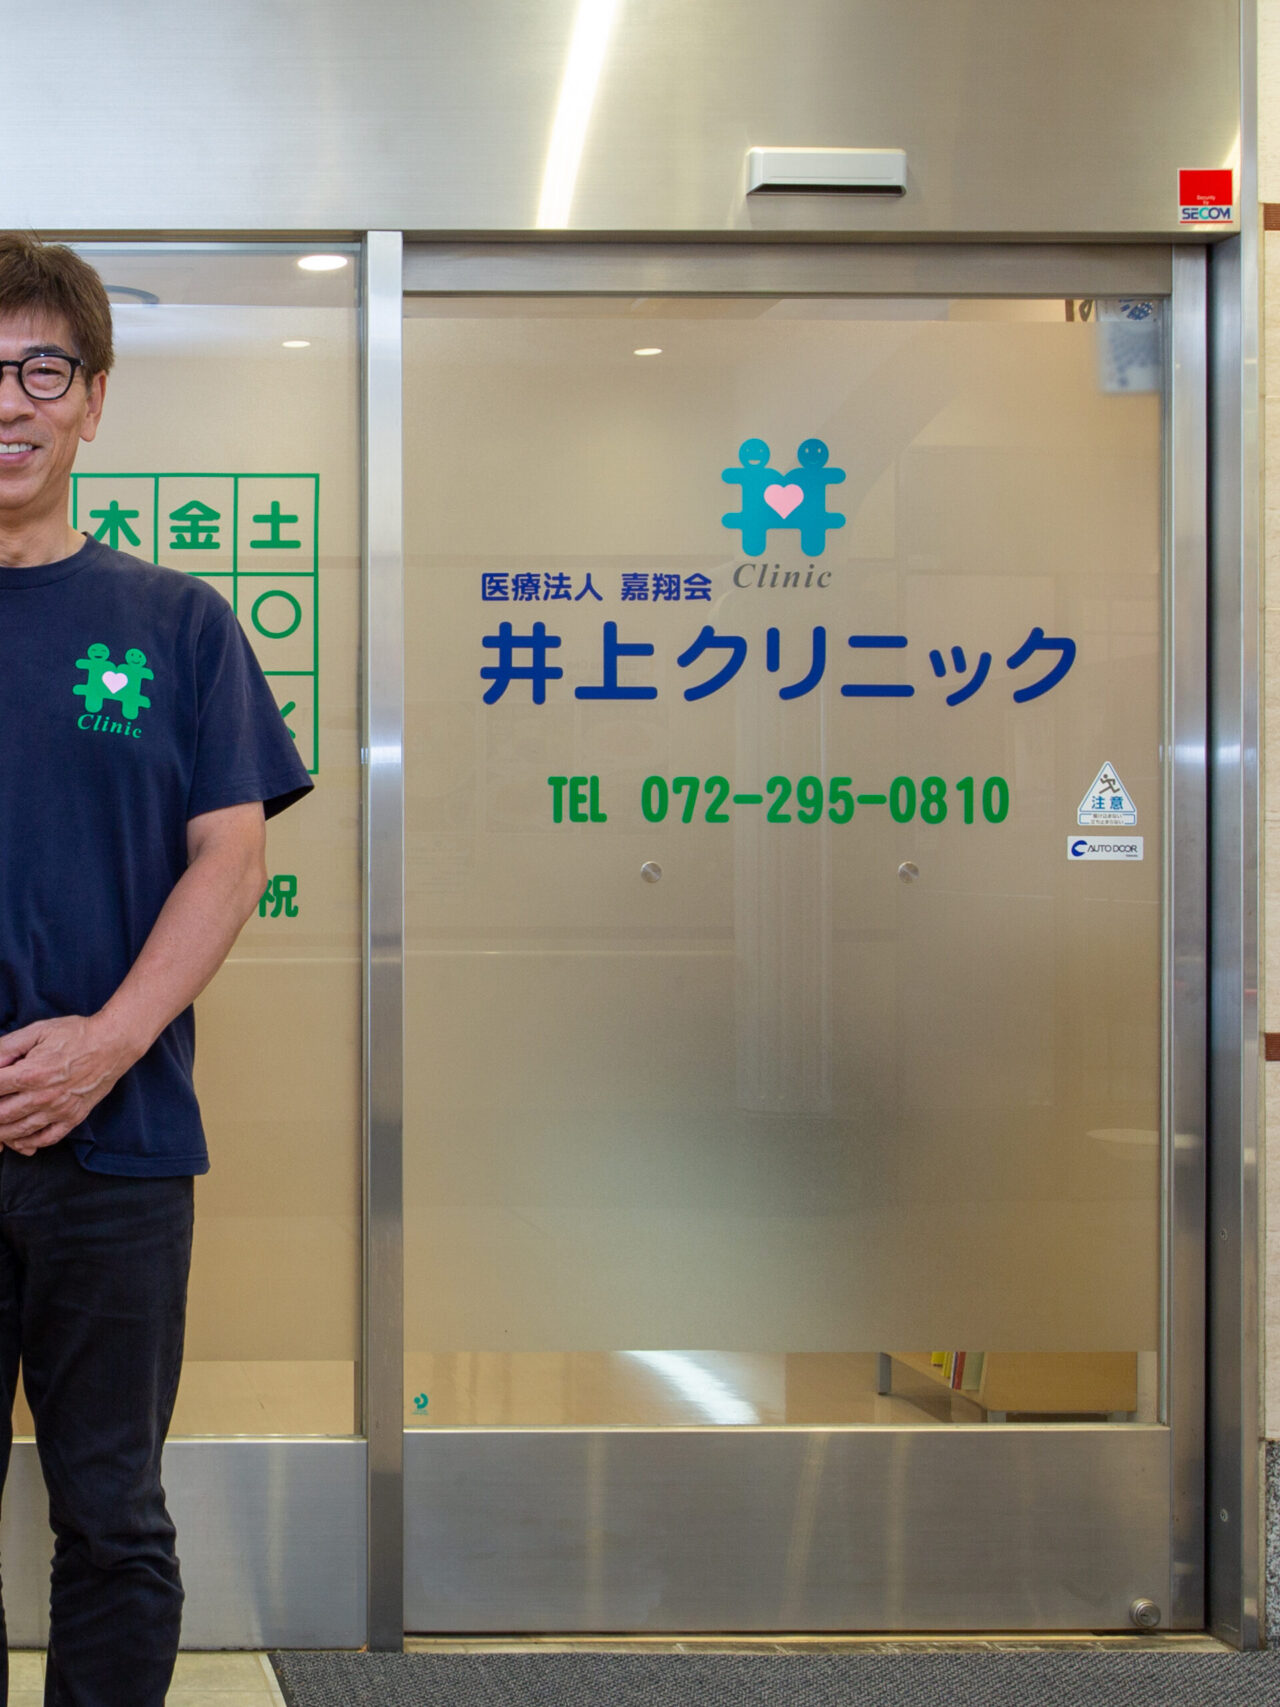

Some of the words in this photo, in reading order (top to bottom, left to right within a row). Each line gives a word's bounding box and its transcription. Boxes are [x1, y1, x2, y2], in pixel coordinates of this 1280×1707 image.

[1181, 206, 1231, 220] SECOM
[88, 499, 142, 550] 木
[168, 499, 221, 550] 金
[249, 499, 302, 550] 土
[481, 571, 604, 602] 医療法人
[621, 571, 713, 602] 嘉翔会
[732, 562, 832, 589] Clinic
[479, 620, 1077, 707] 井上クリニック
[76, 713, 143, 740] Clinic
[546, 774, 608, 824] TEL
[640, 774, 1010, 825] 072-295-0810
[1091, 795, 1124, 811] 注意
[1087, 844, 1112, 853] AUTO
[1112, 844, 1138, 853] DOOR
